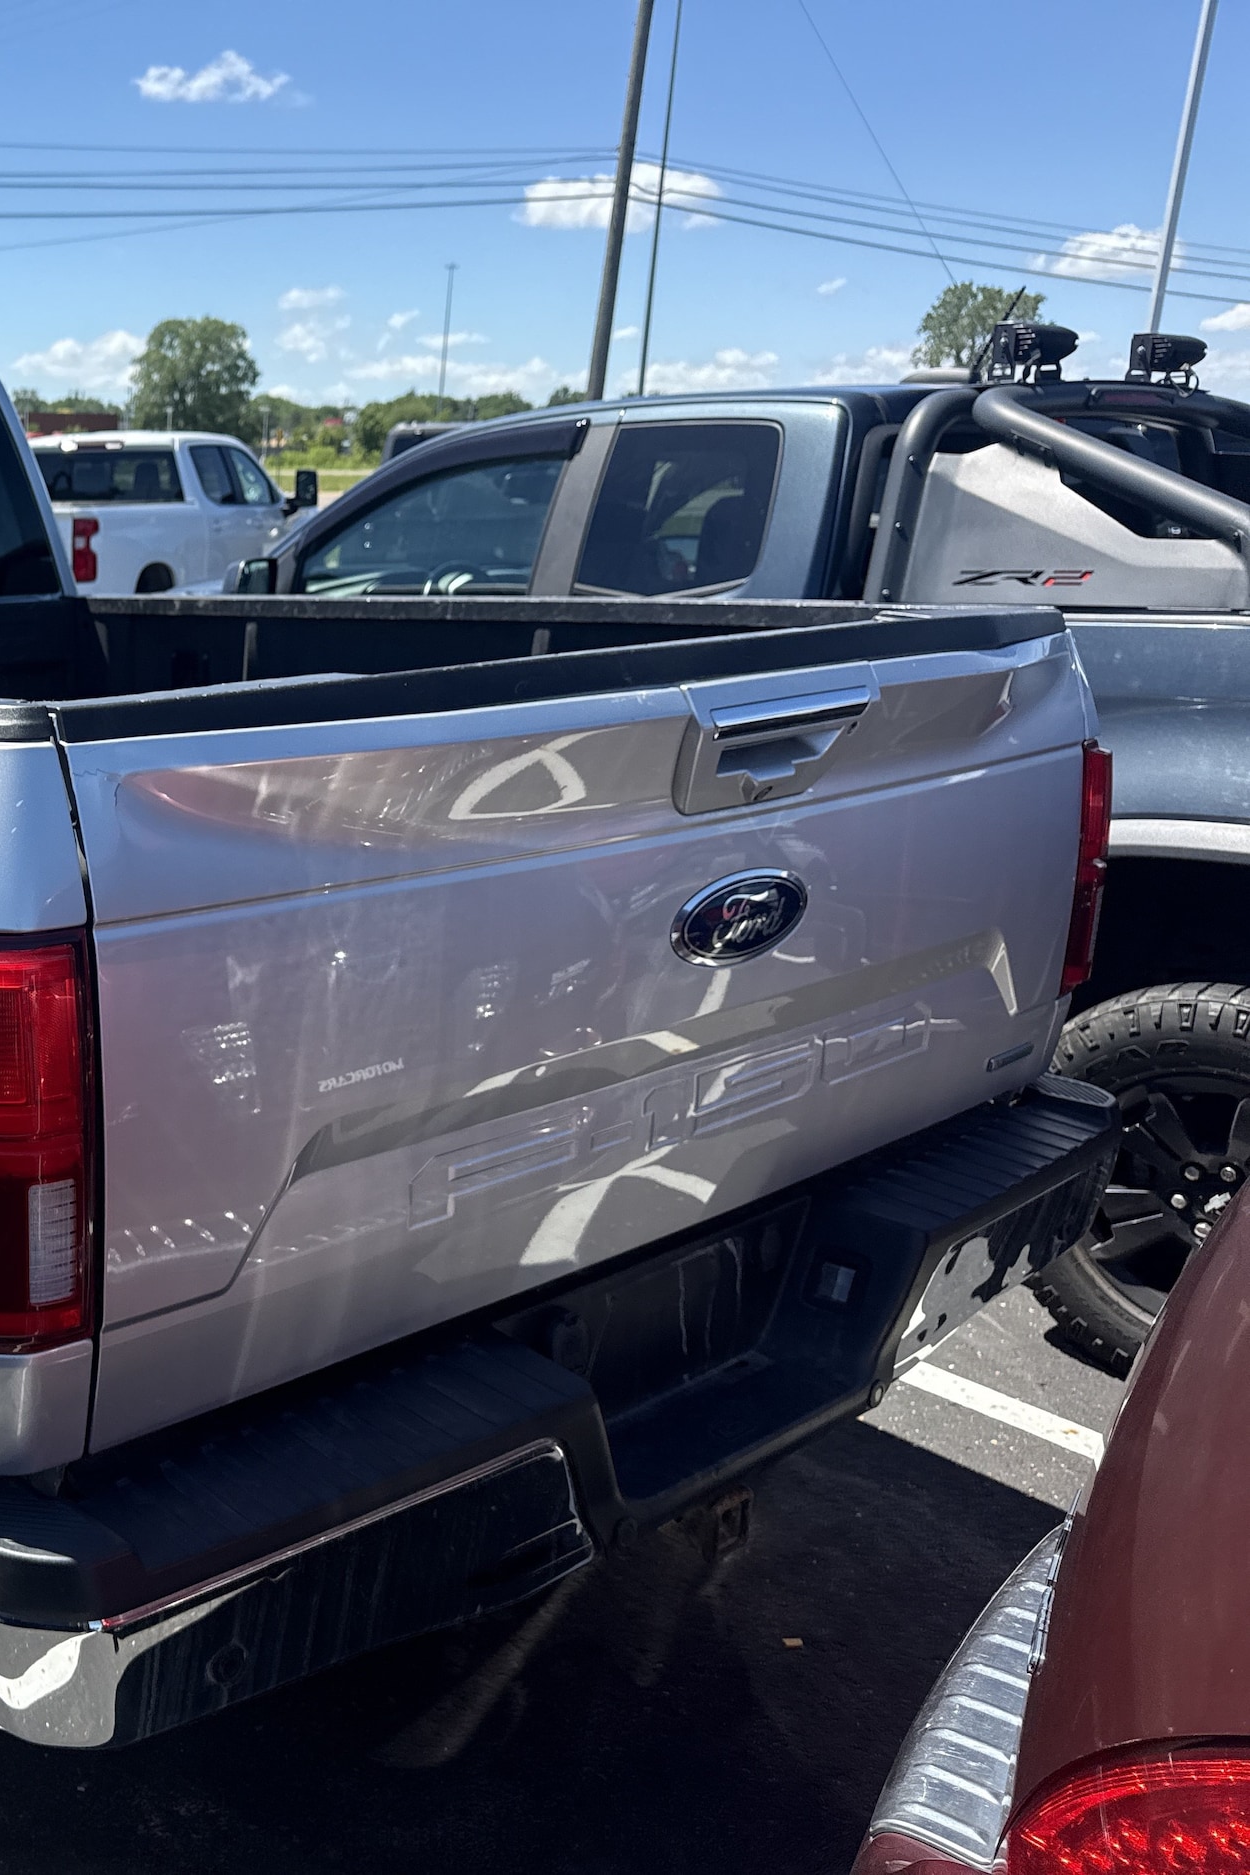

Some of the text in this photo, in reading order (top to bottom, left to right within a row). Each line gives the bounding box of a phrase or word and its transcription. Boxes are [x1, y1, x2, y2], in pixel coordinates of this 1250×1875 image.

[952, 569, 1095, 587] ZR2
[711, 887, 787, 949] Ford
[408, 1000, 932, 1231] F-150
